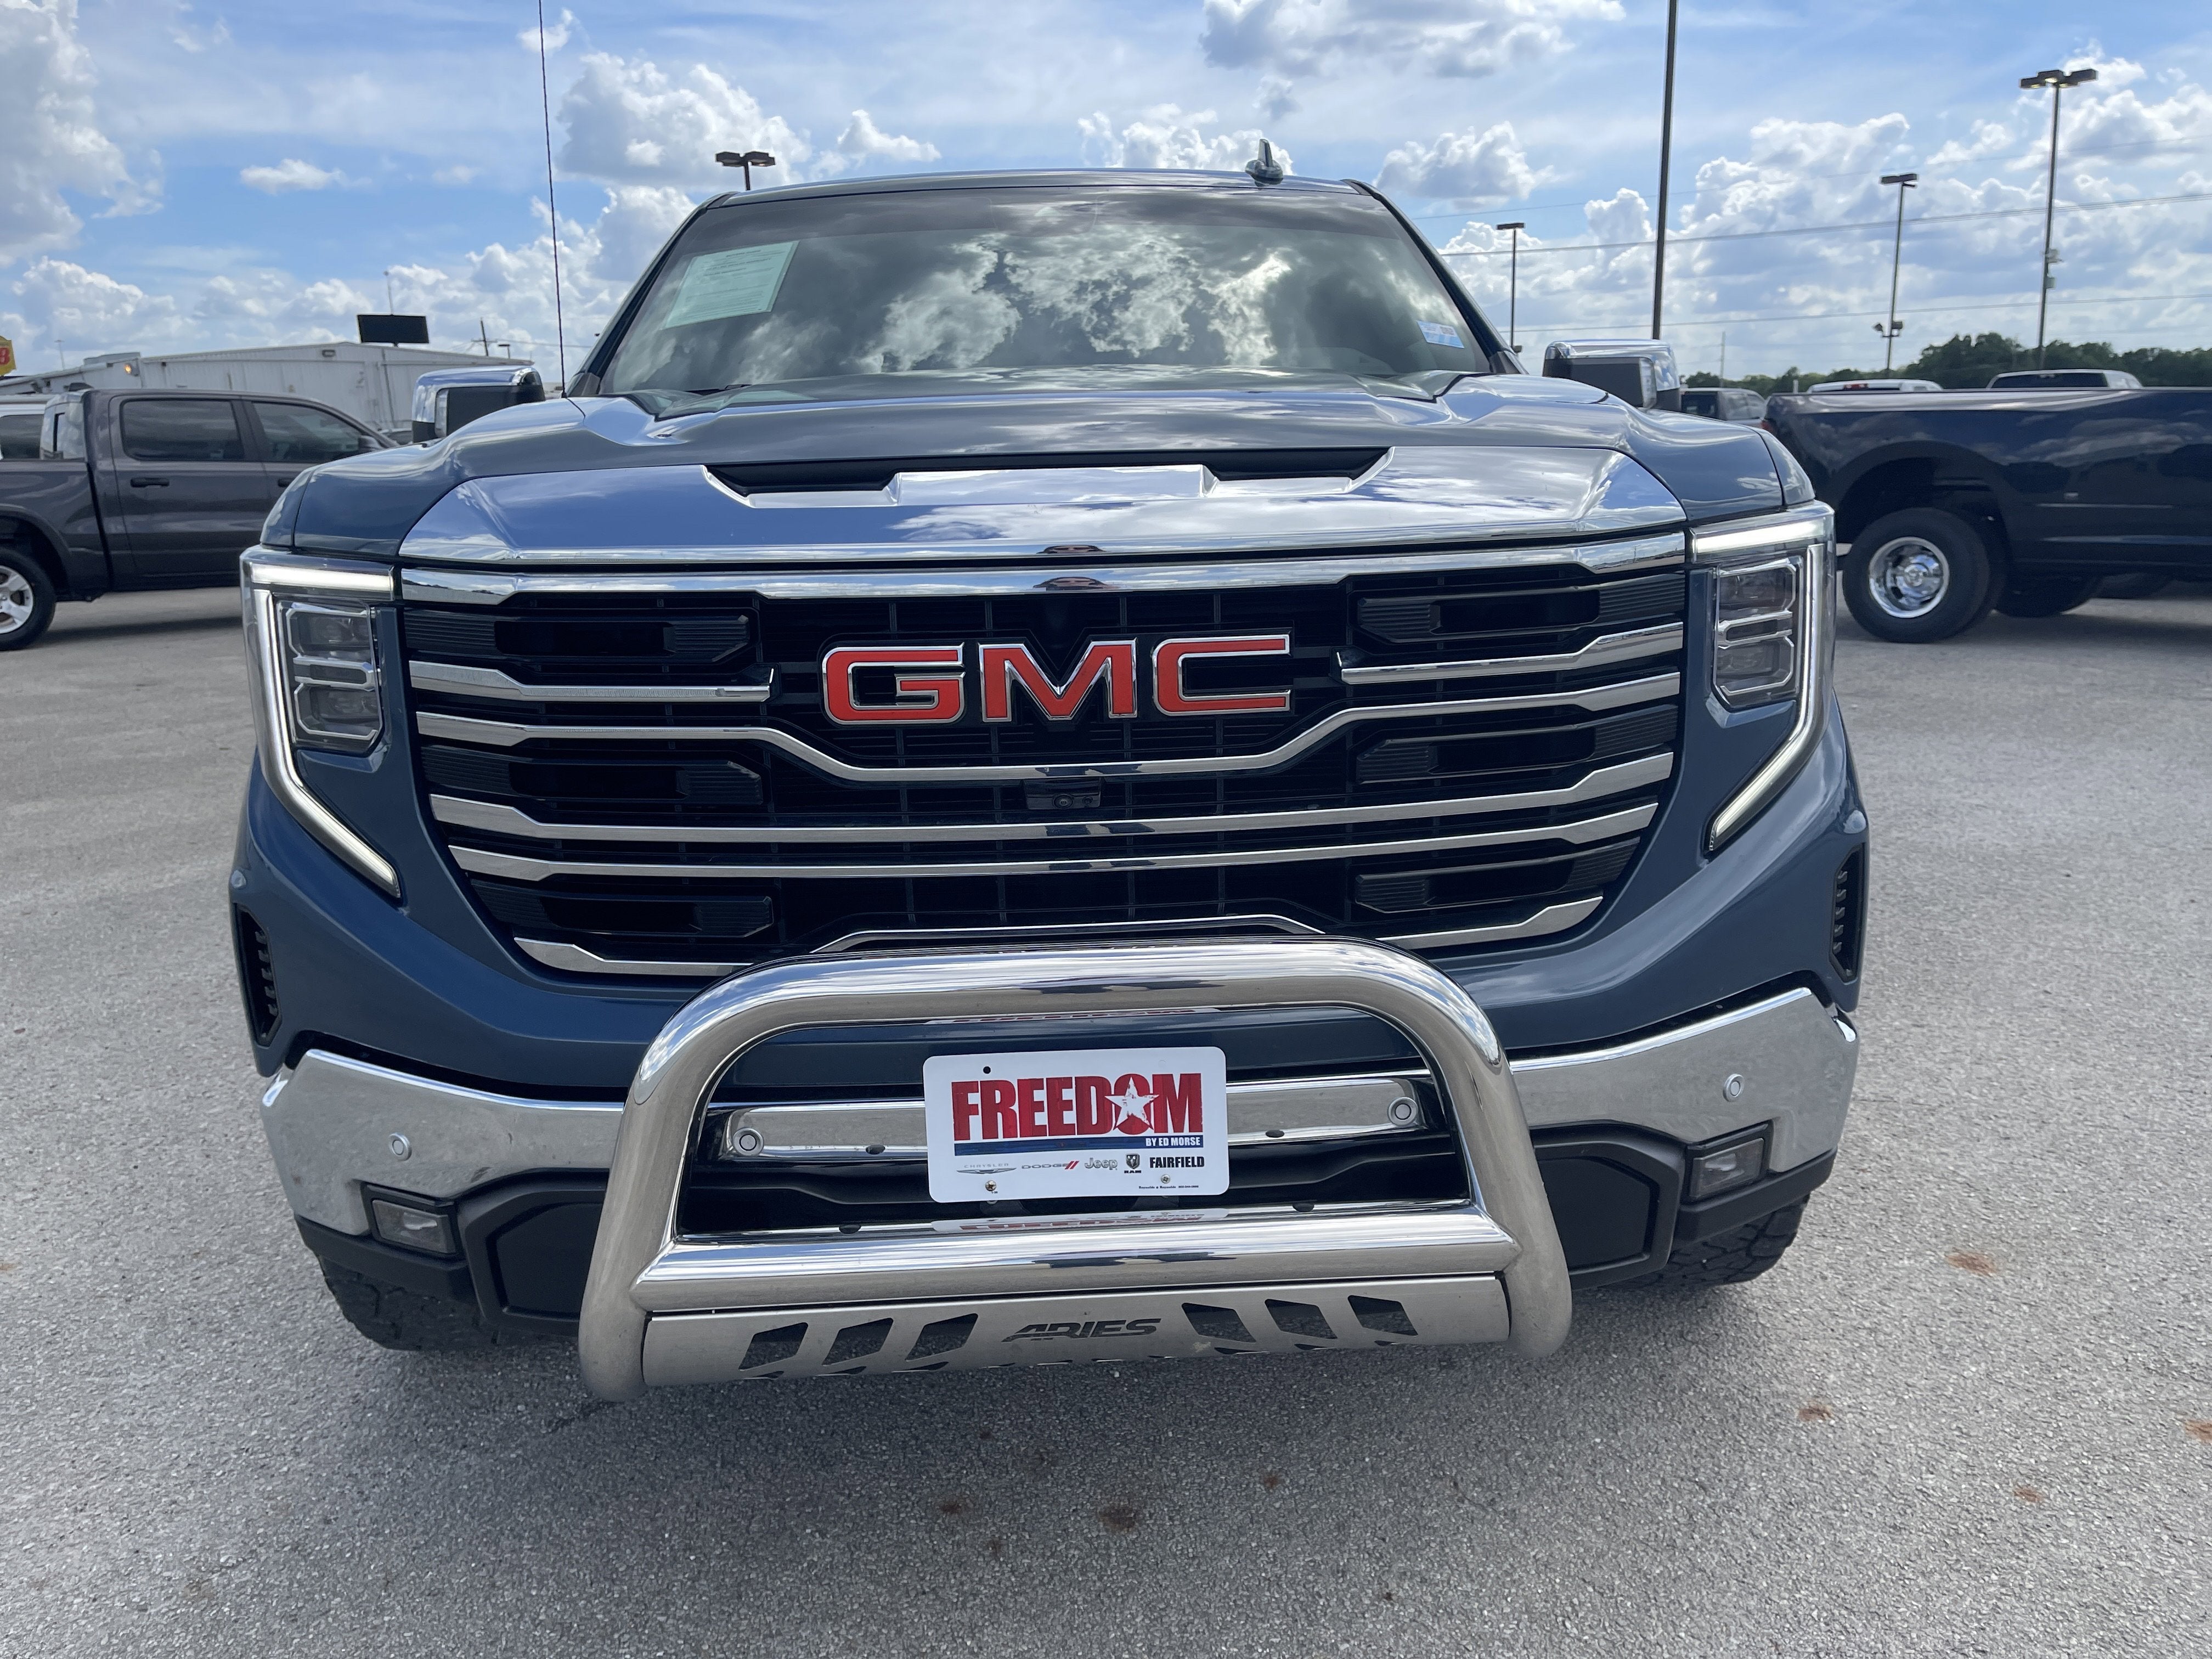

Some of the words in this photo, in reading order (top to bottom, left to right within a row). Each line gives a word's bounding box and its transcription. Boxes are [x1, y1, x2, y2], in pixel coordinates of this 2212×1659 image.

[821, 634, 1291, 724] GMC
[951, 1073, 1203, 1141] FREEDOM
[1146, 1137, 1158, 1147] BY
[1158, 1137, 1169, 1147] ED
[1170, 1137, 1201, 1146] MORSE
[1085, 1158, 1118, 1170] Jeep
[1149, 1156, 1205, 1168] FAIRFIELD
[1001, 1318, 1161, 1342] ARIES
